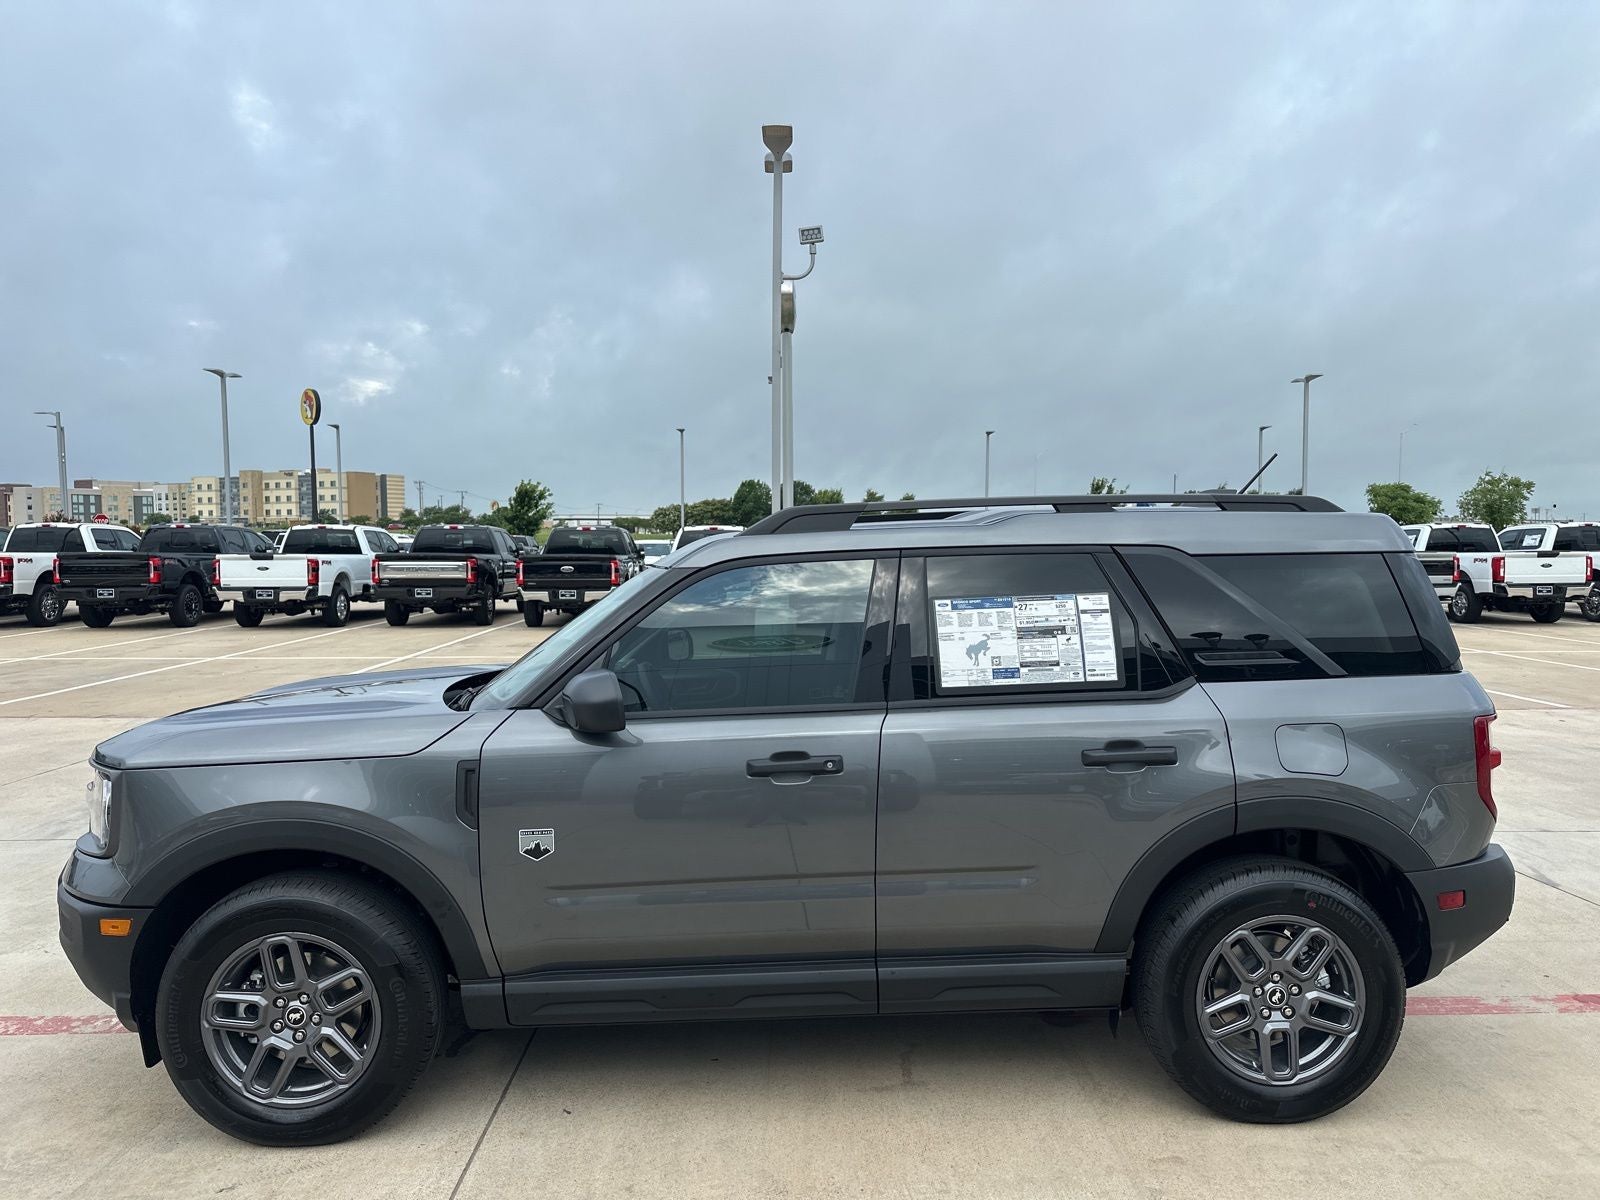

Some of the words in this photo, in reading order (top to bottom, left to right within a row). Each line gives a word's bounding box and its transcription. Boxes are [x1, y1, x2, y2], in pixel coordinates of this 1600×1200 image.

[1018, 603, 1028, 611] 27
[1303, 890, 1376, 938] Continental
[167, 980, 188, 1069] Continental
[389, 977, 409, 1060] Continental
